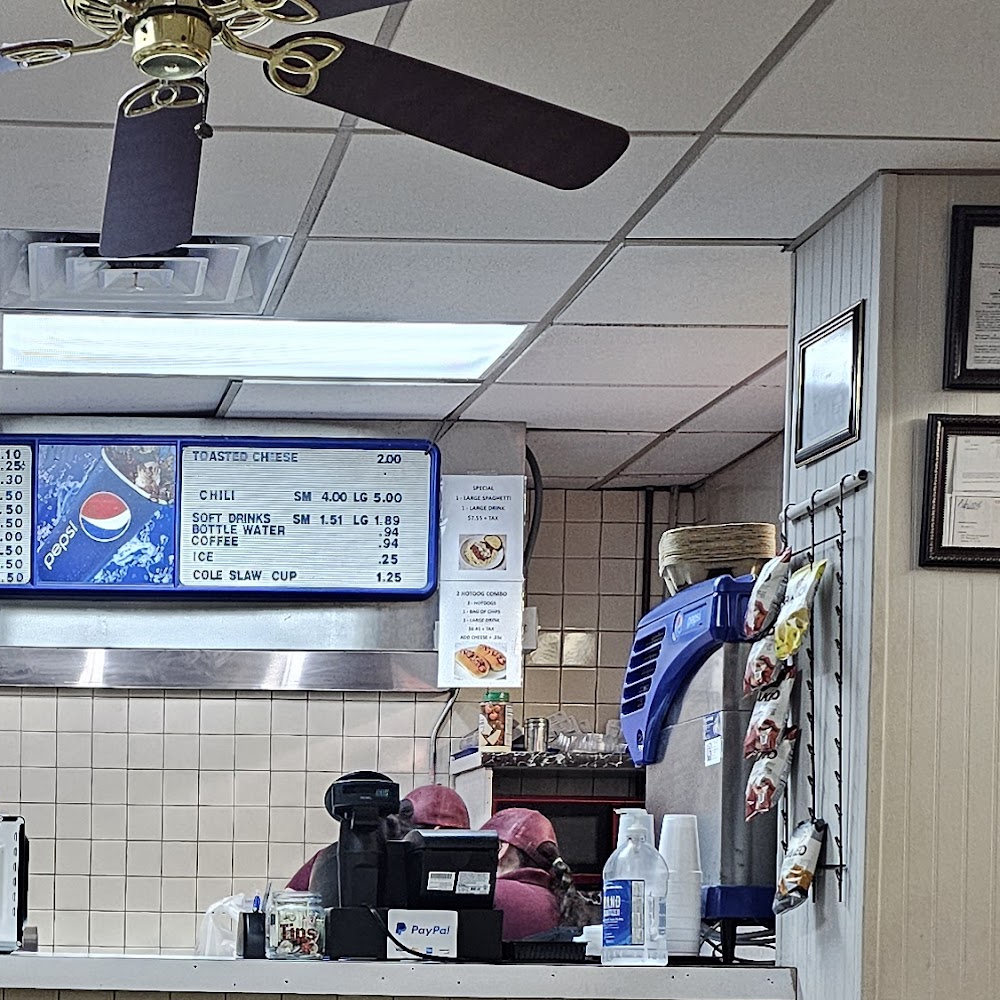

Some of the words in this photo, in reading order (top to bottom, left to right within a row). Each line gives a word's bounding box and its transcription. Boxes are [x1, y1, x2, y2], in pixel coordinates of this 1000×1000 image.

[193, 451, 248, 462] TOASTED
[253, 452, 298, 463] CHEESE
[377, 454, 402, 464] 2.00
[199, 490, 235, 501] CHILI
[294, 491, 312, 502] SM
[321, 492, 347, 502] 4.00
[353, 492, 368, 502] LG
[373, 492, 402, 503] 5.00
[192, 513, 221, 523] SOFT
[228, 513, 271, 523] DRINKS
[292, 514, 310, 525] SM
[320, 514, 343, 525] 1.51
[353, 515, 368, 525] LG
[374, 515, 400, 526] 1.89
[192, 524, 237, 534] BOTTLE
[243, 525, 285, 535] WATER
[379, 527, 399, 537] .94
[44, 520, 78, 570] pepsi
[191, 536, 239, 546] COFFEE
[378, 538, 398, 548] .94
[193, 552, 214, 562] ICE
[378, 555, 398, 564] .25
[193, 570, 223, 580] COLE
[229, 571, 262, 581] SLAW
[271, 571, 297, 581] CUP
[376, 572, 402, 582] 1.25
[280, 923, 318, 943] Tips
[411, 926, 450, 936] PayPal
